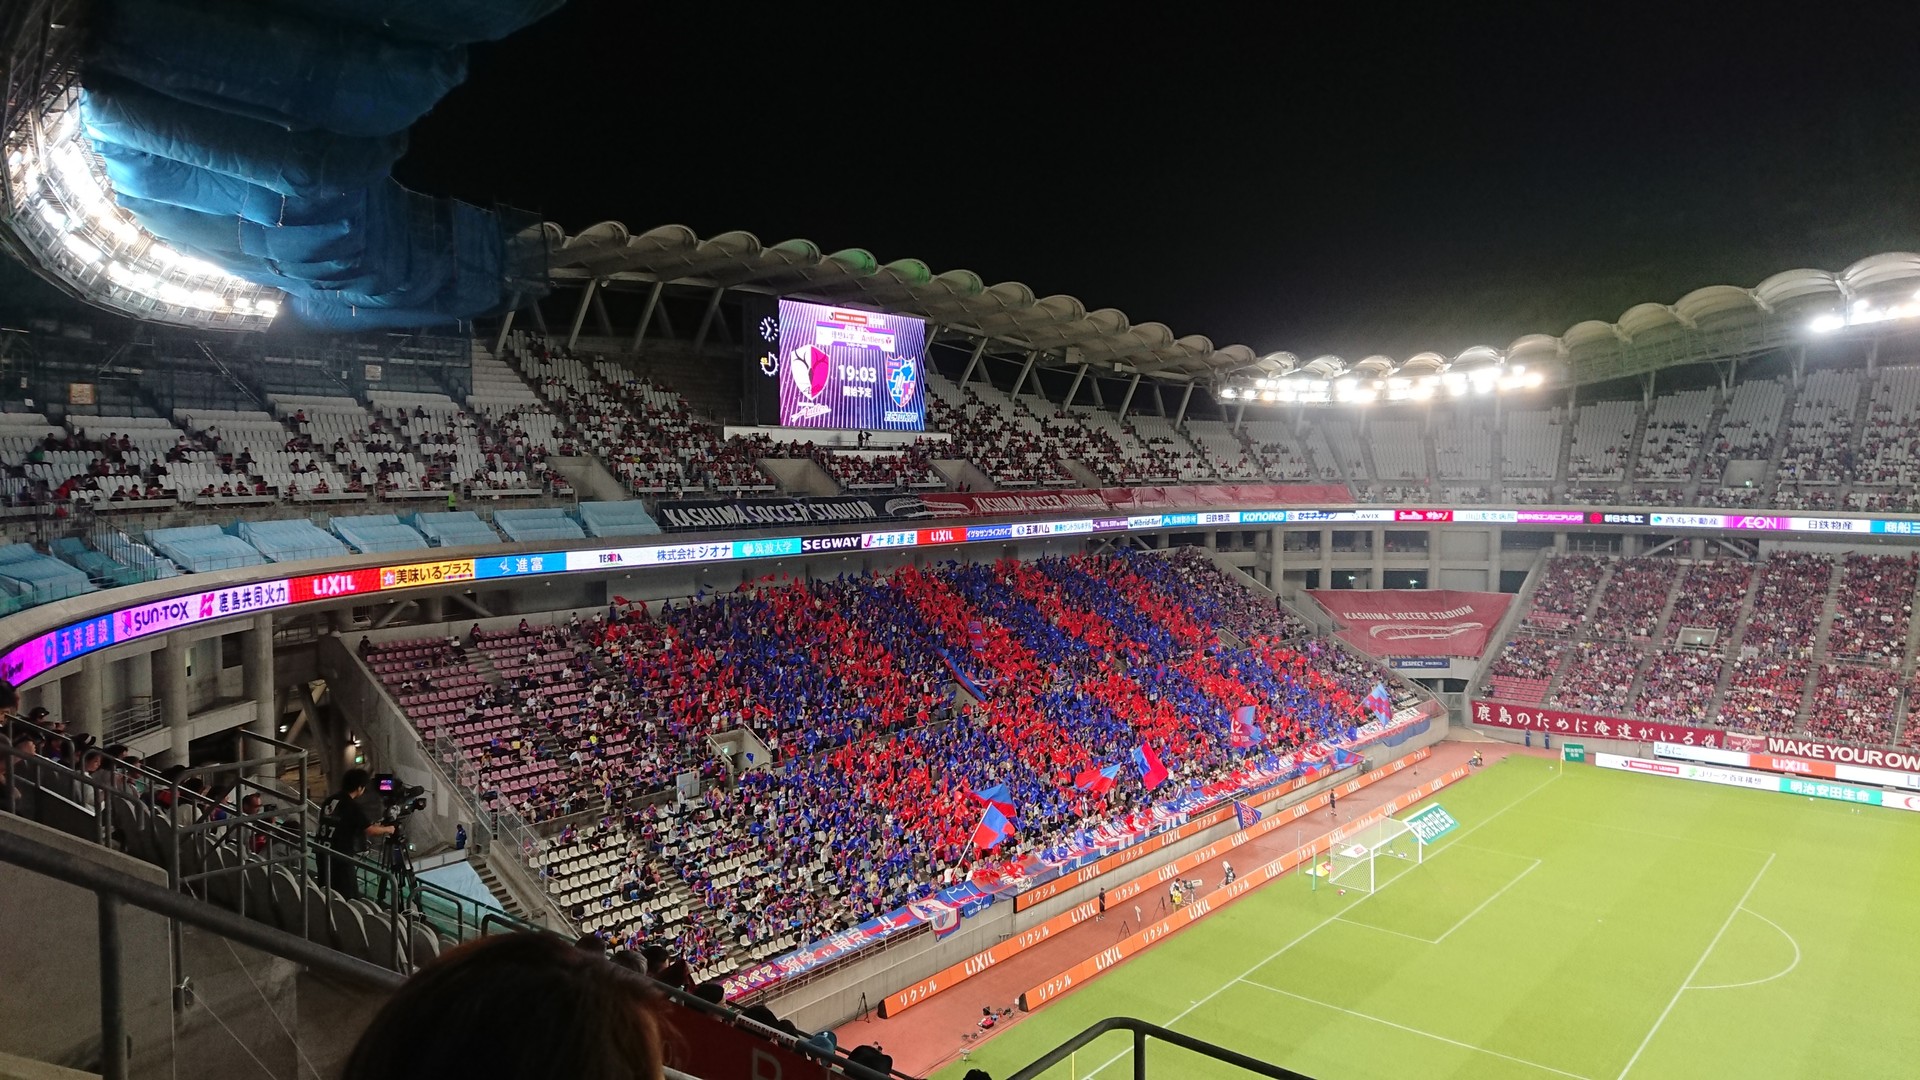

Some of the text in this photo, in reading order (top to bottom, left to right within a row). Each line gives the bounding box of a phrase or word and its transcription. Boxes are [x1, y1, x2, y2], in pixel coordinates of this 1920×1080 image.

[838, 365, 877, 382] 19:03
[663, 500, 876, 527] KASHIMA SOCCER STADIUM
[972, 495, 1026, 512] KASHIMA
[1023, 495, 1063, 509] SOCCER
[1808, 519, 1853, 530] 日鉄物産
[802, 536, 860, 551] SEGWAY
[931, 530, 954, 542] LIXIL
[516, 556, 543, 573] 進富
[313, 575, 355, 595] LIXIL
[218, 582, 287, 612] 鹿島共同火力
[1343, 605, 1475, 621] KASHIMA SOCCER STADIUM
[61, 618, 108, 658] 五洋建設
[1768, 738, 1825, 758] MAKE
[1826, 744, 1882, 765] YOUR
[1772, 758, 1811, 773] LIXIL
[1790, 780, 1870, 802] 明治安田生命
[1028, 884, 1056, 904] リクシル
[1078, 864, 1100, 882] LIXIL
[1161, 830, 1181, 846] LIXIL
[900, 980, 937, 1006] リクシル
[965, 951, 996, 976] LIXIL
[1019, 926, 1049, 947] リクシル
[1071, 903, 1096, 923] LIXIL
[1115, 883, 1140, 901] リクシル
[1157, 863, 1179, 881] LIXIL
[1231, 832, 1249, 847] LIXIL
[829, 927, 871, 953] 東京
[1039, 974, 1071, 1000] リクシル
[1095, 946, 1123, 970] LIXIL
[1142, 923, 1169, 943] リクシル
[1188, 899, 1212, 920] LIXIL
[1227, 879, 1249, 897] リクシル
[1264, 861, 1284, 879] LIXIL
